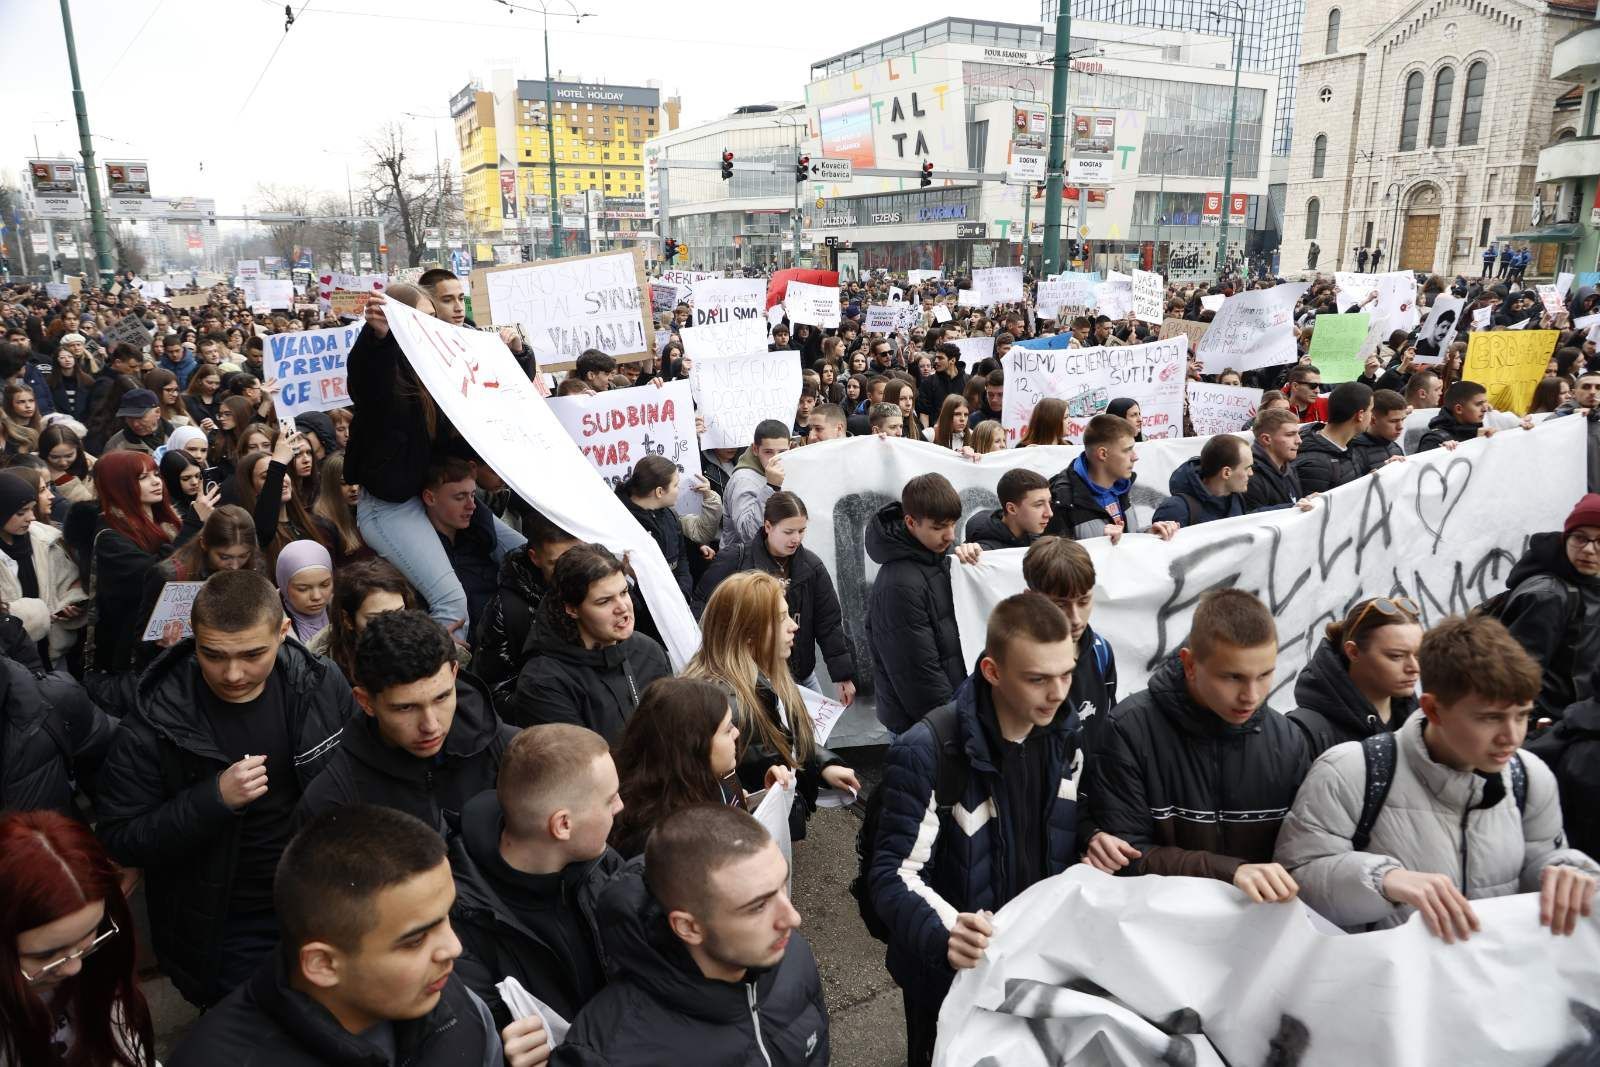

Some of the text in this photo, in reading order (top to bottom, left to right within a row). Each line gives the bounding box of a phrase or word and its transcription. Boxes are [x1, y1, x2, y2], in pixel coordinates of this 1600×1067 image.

[984, 48, 1028, 59] FOUR SEASONS
[557, 89, 624, 101] HOTEL HOLIDAY
[821, 170, 850, 179] Grbavica
[270, 334, 337, 362] VLADA
[1012, 351, 1056, 374] NISMO
[1145, 344, 1179, 365] KOJA
[1203, 391, 1224, 405] SMO
[582, 399, 675, 437] SUDBINA
[642, 433, 665, 456] to
